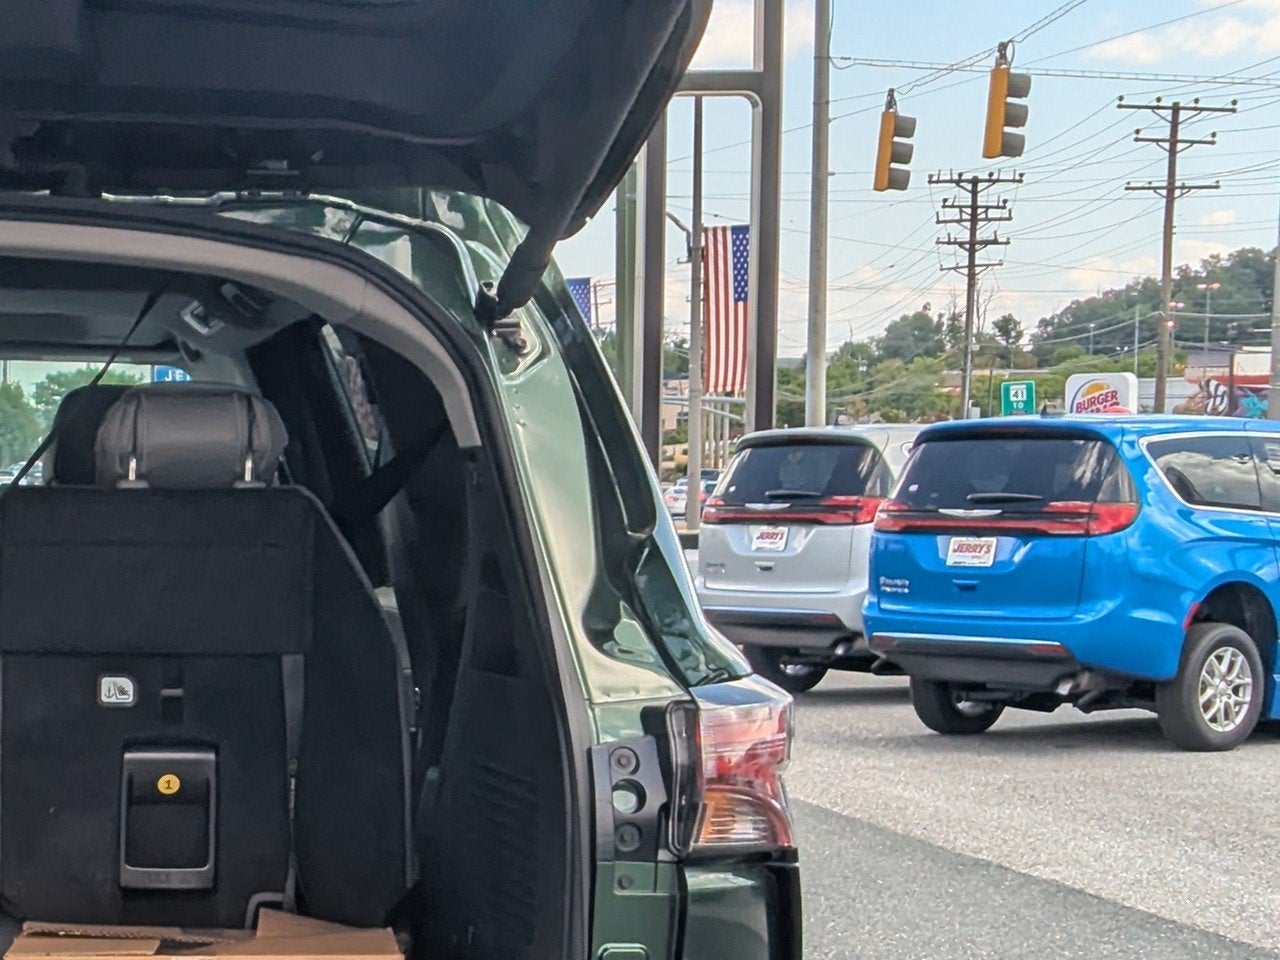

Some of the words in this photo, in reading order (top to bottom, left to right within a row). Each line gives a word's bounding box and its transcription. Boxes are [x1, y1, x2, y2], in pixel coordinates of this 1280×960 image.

[165, 369, 191, 381] JE
[1076, 390, 1118, 413] BURGER
[952, 543, 992, 554] JERRY'S
